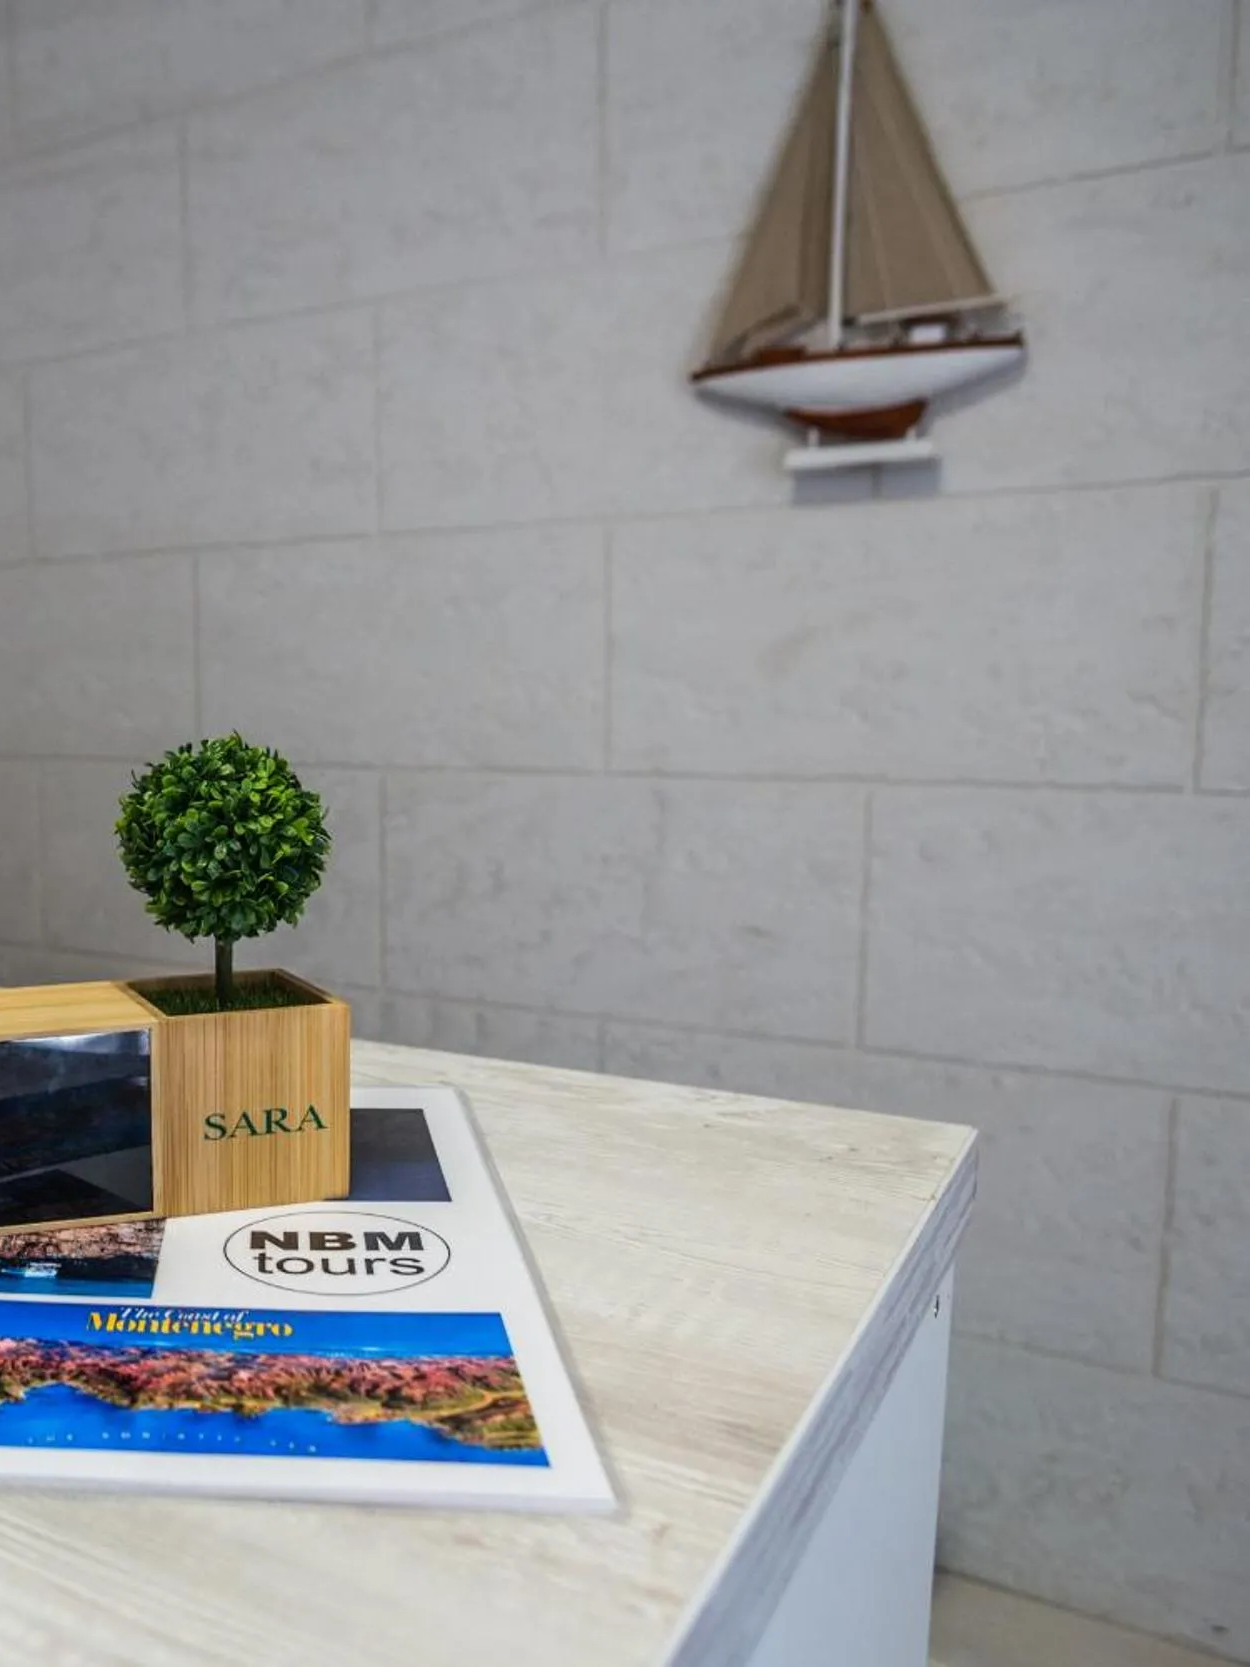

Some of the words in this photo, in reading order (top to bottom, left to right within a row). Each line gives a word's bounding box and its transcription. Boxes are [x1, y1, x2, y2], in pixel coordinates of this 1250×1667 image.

[203, 1104, 329, 1141] SARA
[250, 1231, 424, 1251] NBM
[254, 1252, 425, 1276] tours
[86, 1311, 294, 1340] Montenegro
[121, 1307, 159, 1320] The
